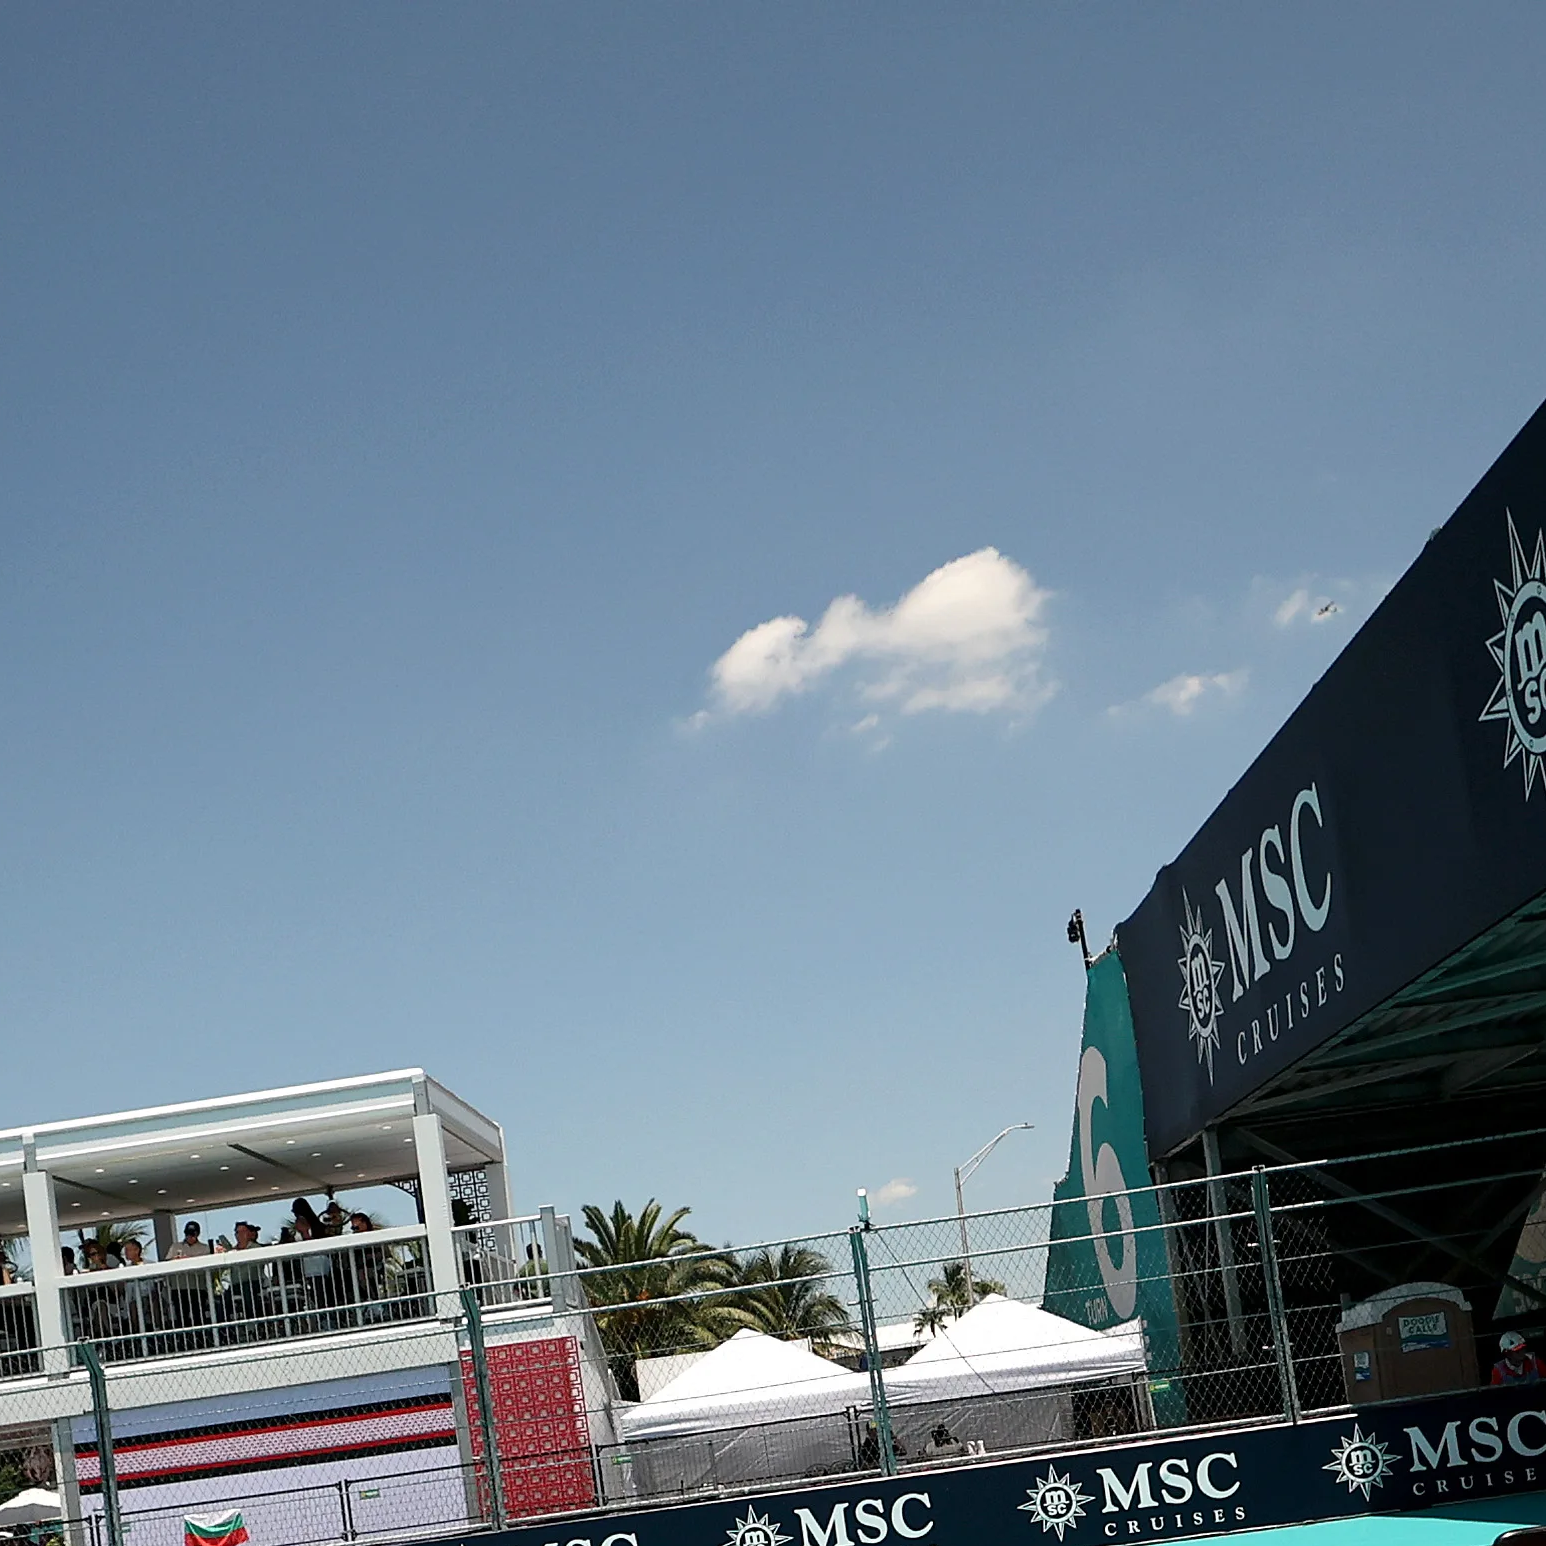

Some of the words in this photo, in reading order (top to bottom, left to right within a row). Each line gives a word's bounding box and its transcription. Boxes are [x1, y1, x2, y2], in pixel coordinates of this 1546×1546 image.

[1215, 781, 1331, 1003] MSC
[1236, 953, 1344, 1065] CRUISES
[1079, 1046, 1137, 1319] 6
[1085, 1297, 1109, 1325] TURN
[1096, 1453, 1240, 1513] MSC
[1104, 1506, 1246, 1537] CRUISES
